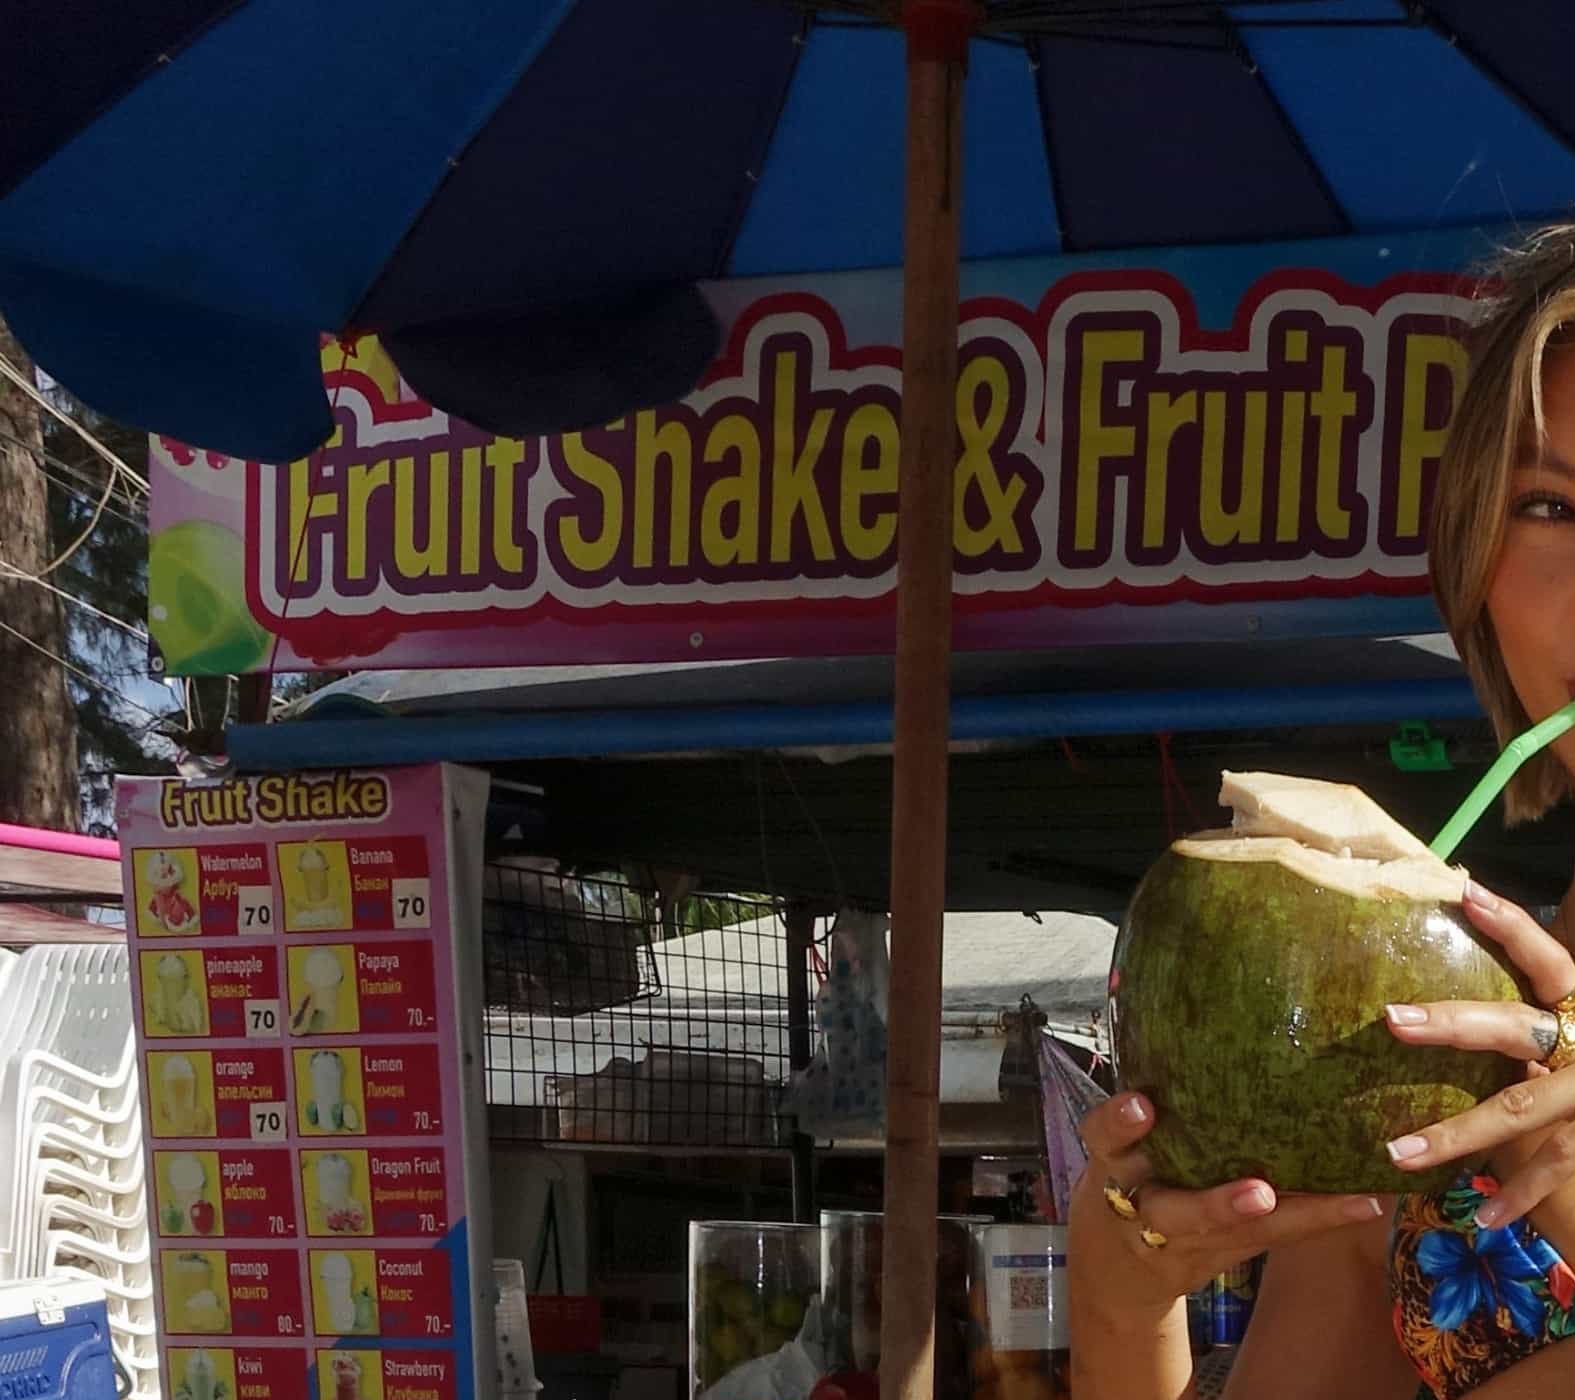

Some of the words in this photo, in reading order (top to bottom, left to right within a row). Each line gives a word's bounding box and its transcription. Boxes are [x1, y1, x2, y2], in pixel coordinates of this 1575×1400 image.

[287, 418, 540, 596] Fruit
[555, 331, 907, 581] Shake
[1058, 309, 1366, 567] Fruit
[162, 778, 252, 827] Fruit
[255, 772, 388, 822] Shake
[201, 854, 262, 872] Watermelon
[351, 848, 393, 865] Banana
[245, 905, 270, 925] 70
[398, 897, 425, 917] 70
[207, 957, 262, 976] pineapple
[359, 952, 399, 971] Papaya
[251, 1012, 274, 1029] 70
[408, 1008, 434, 1025] 70.-
[216, 1060, 254, 1077] orange
[365, 1056, 403, 1073] Lemon
[255, 1113, 280, 1132] 70
[414, 1112, 440, 1129] 70.-
[223, 1160, 254, 1178] apple
[371, 1159, 412, 1177] Dragon
[415, 1159, 441, 1174] Fruit
[269, 1216, 295, 1233] 70.-
[420, 1214, 446, 1231] 70.-
[230, 1262, 269, 1278] mango
[378, 1261, 423, 1277] Coconut
[278, 1316, 302, 1332] 80.-
[425, 1316, 451, 1333] 70.-
[238, 1359, 263, 1375] kiwi
[385, 1360, 445, 1380] Strawberry
